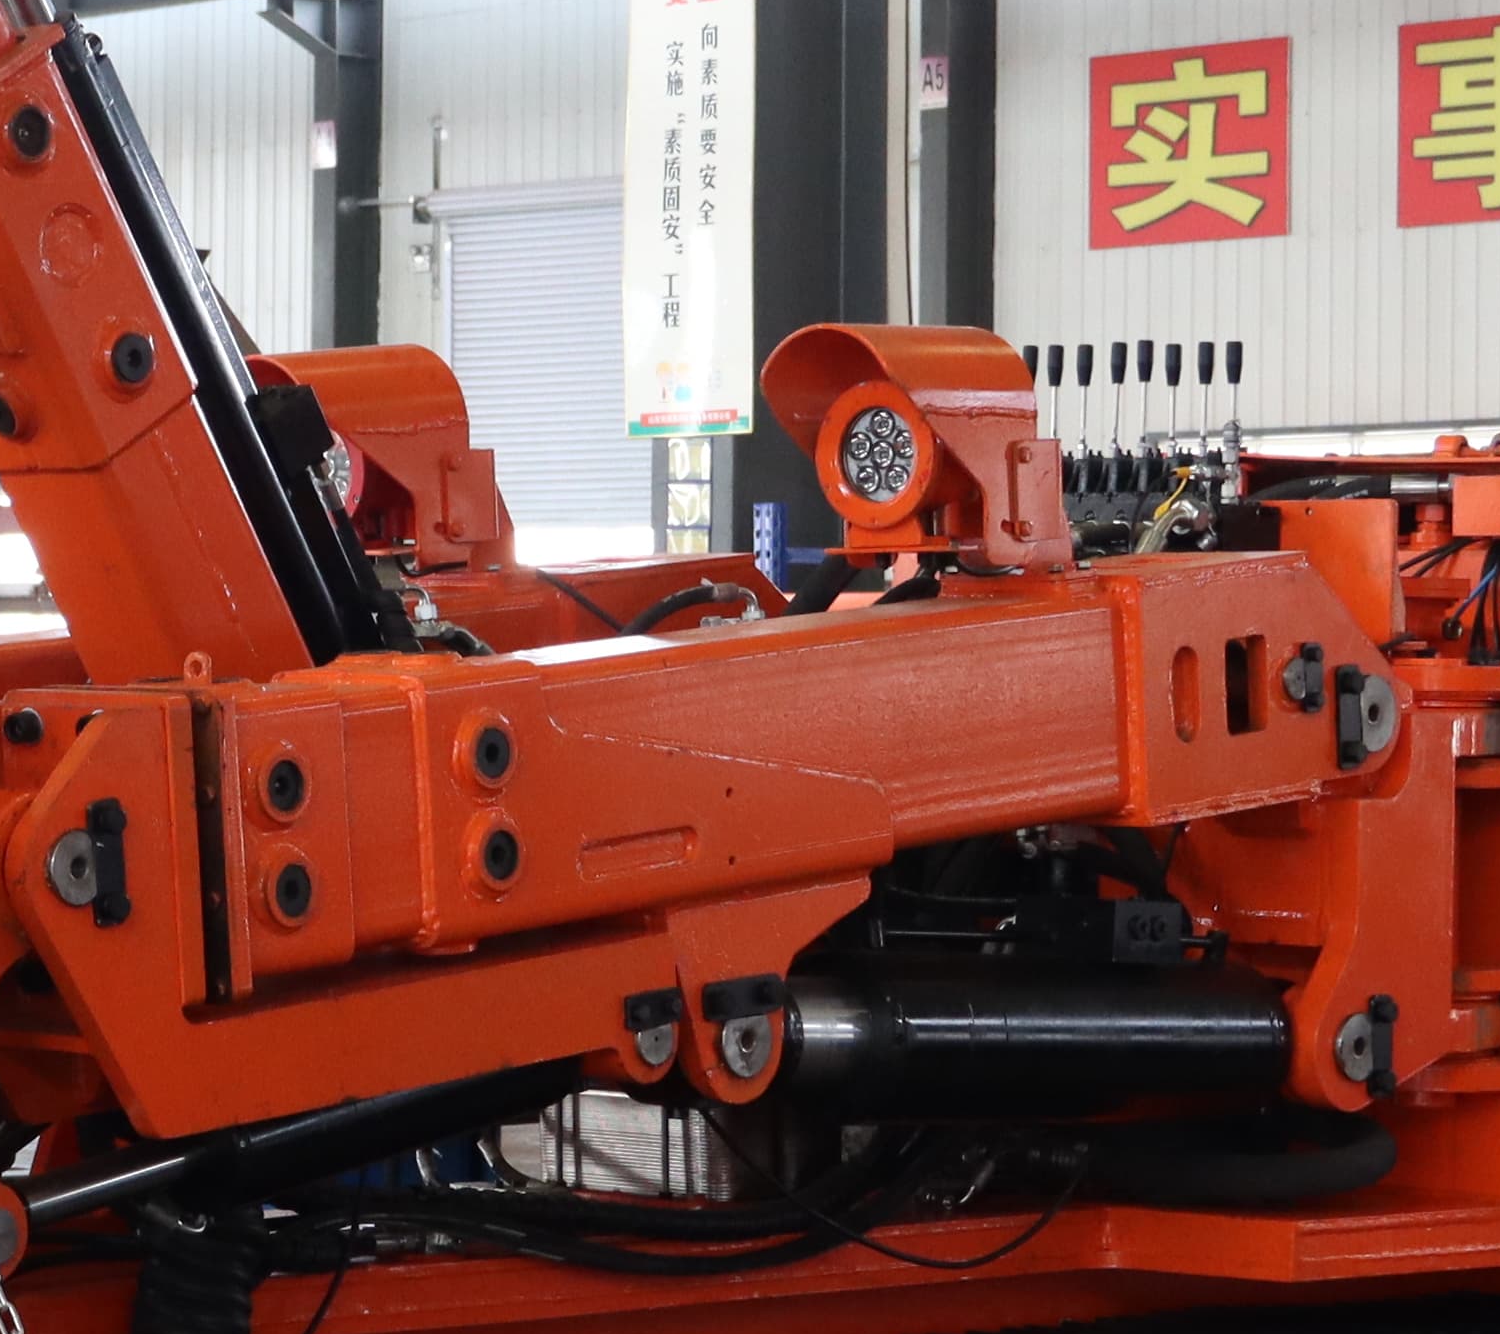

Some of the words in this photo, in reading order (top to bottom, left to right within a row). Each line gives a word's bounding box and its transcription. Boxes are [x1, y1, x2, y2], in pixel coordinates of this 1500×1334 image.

[697, 22, 720, 227] 向素质要安全
[921, 63, 945, 93] A5
